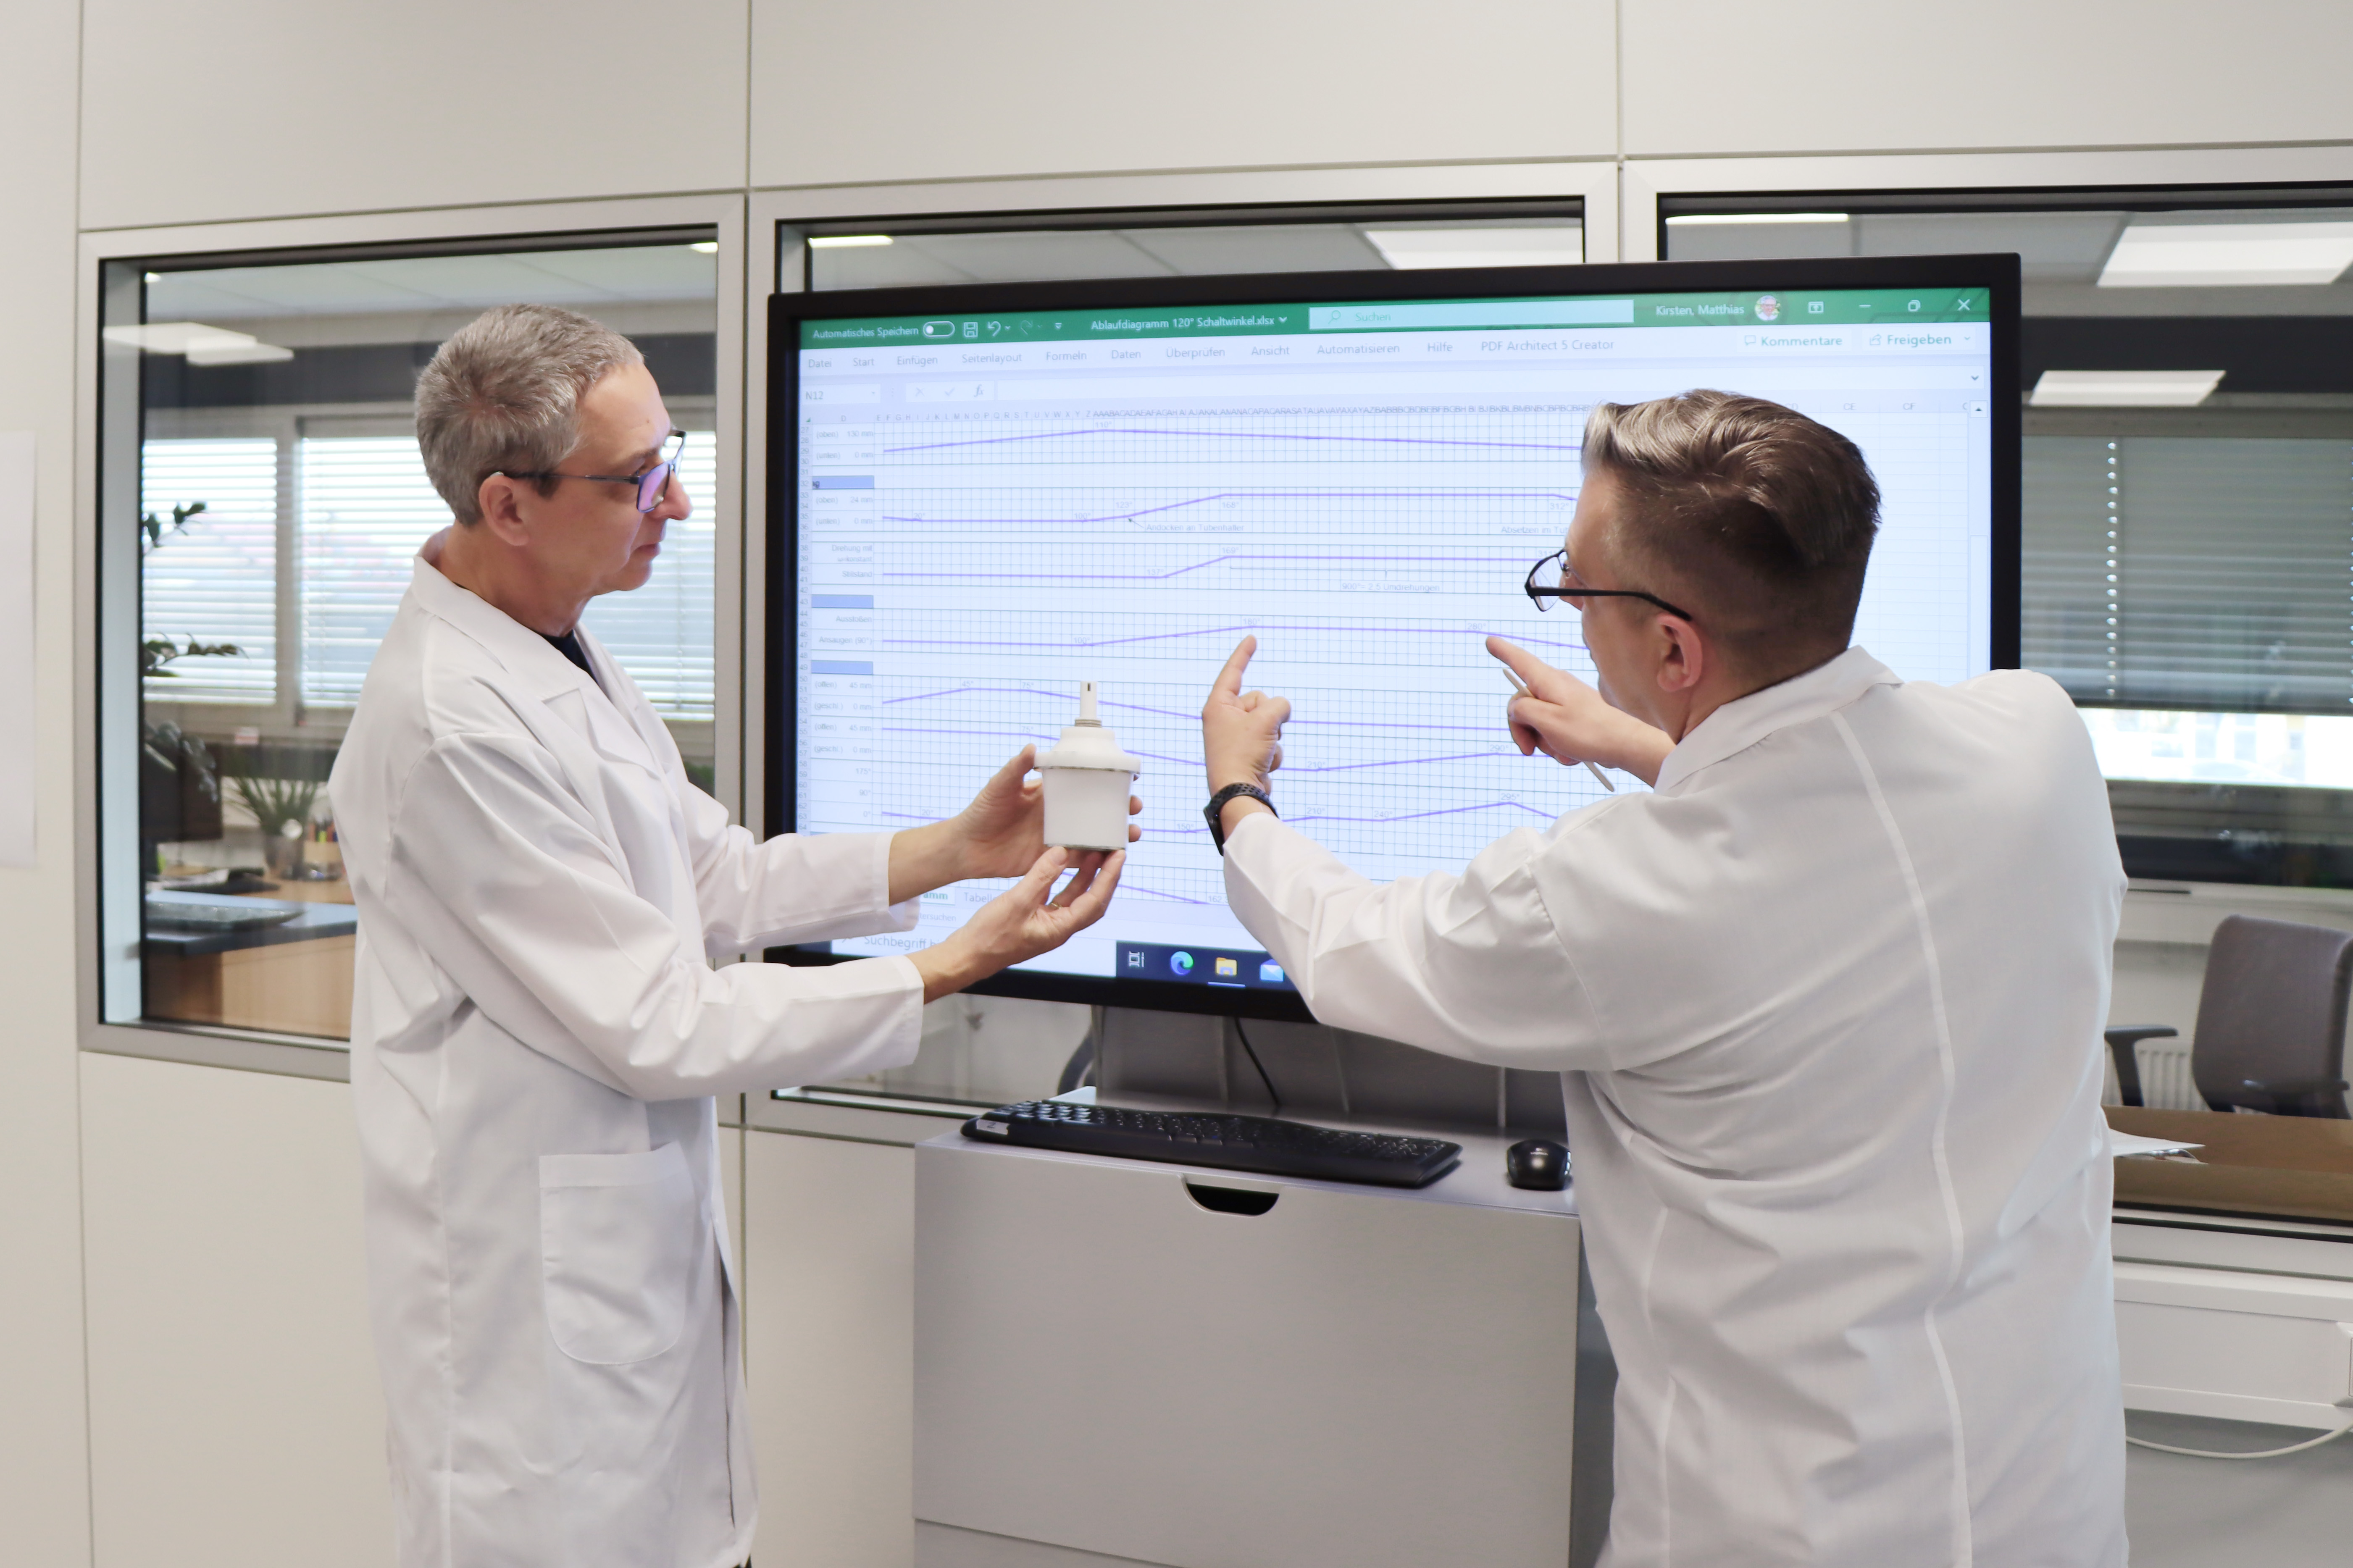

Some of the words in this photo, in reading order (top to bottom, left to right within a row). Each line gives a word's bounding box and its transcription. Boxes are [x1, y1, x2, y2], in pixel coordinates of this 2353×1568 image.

[1656, 305, 1694, 316] Kirsten,
[1698, 304, 1744, 315] Matthias
[1355, 312, 1391, 322] Suchen
[1091, 318, 1169, 331] Ablaufdiagramm
[1173, 318, 1194, 328] 120°
[1197, 315, 1275, 328] Schaltwinkel.xlsx
[813, 328, 875, 339] Automatisches
[877, 326, 919, 337] Speichern
[1428, 341, 1454, 352] Hilfe
[1480, 341, 1503, 351] PDF
[1506, 339, 1558, 351] Architect
[1561, 340, 1568, 350] 5
[1572, 339, 1614, 350] Creator
[1761, 336, 1843, 347] Kommentare
[1887, 334, 1951, 348] Freigeben
[1165, 346, 1225, 360] Überprüfen
[1251, 344, 1290, 356] Ansicht
[1317, 342, 1400, 355] Automatisieren
[962, 353, 1022, 365] Seitenlayout
[1046, 350, 1087, 361] Formeln
[1111, 349, 1141, 360] Daten
[808, 358, 832, 368] Datei
[853, 357, 874, 367] Start
[897, 355, 938, 367] Einfügen
[805, 391, 824, 401] N12
[1843, 402, 1856, 411] CE
[1902, 402, 1916, 410] CF
[1384, 583, 1440, 592] Umdrehungen
[819, 636, 853, 645] Ansaugen
[855, 637, 872, 645] (90°)
[864, 935, 926, 951] Suchbegriff
